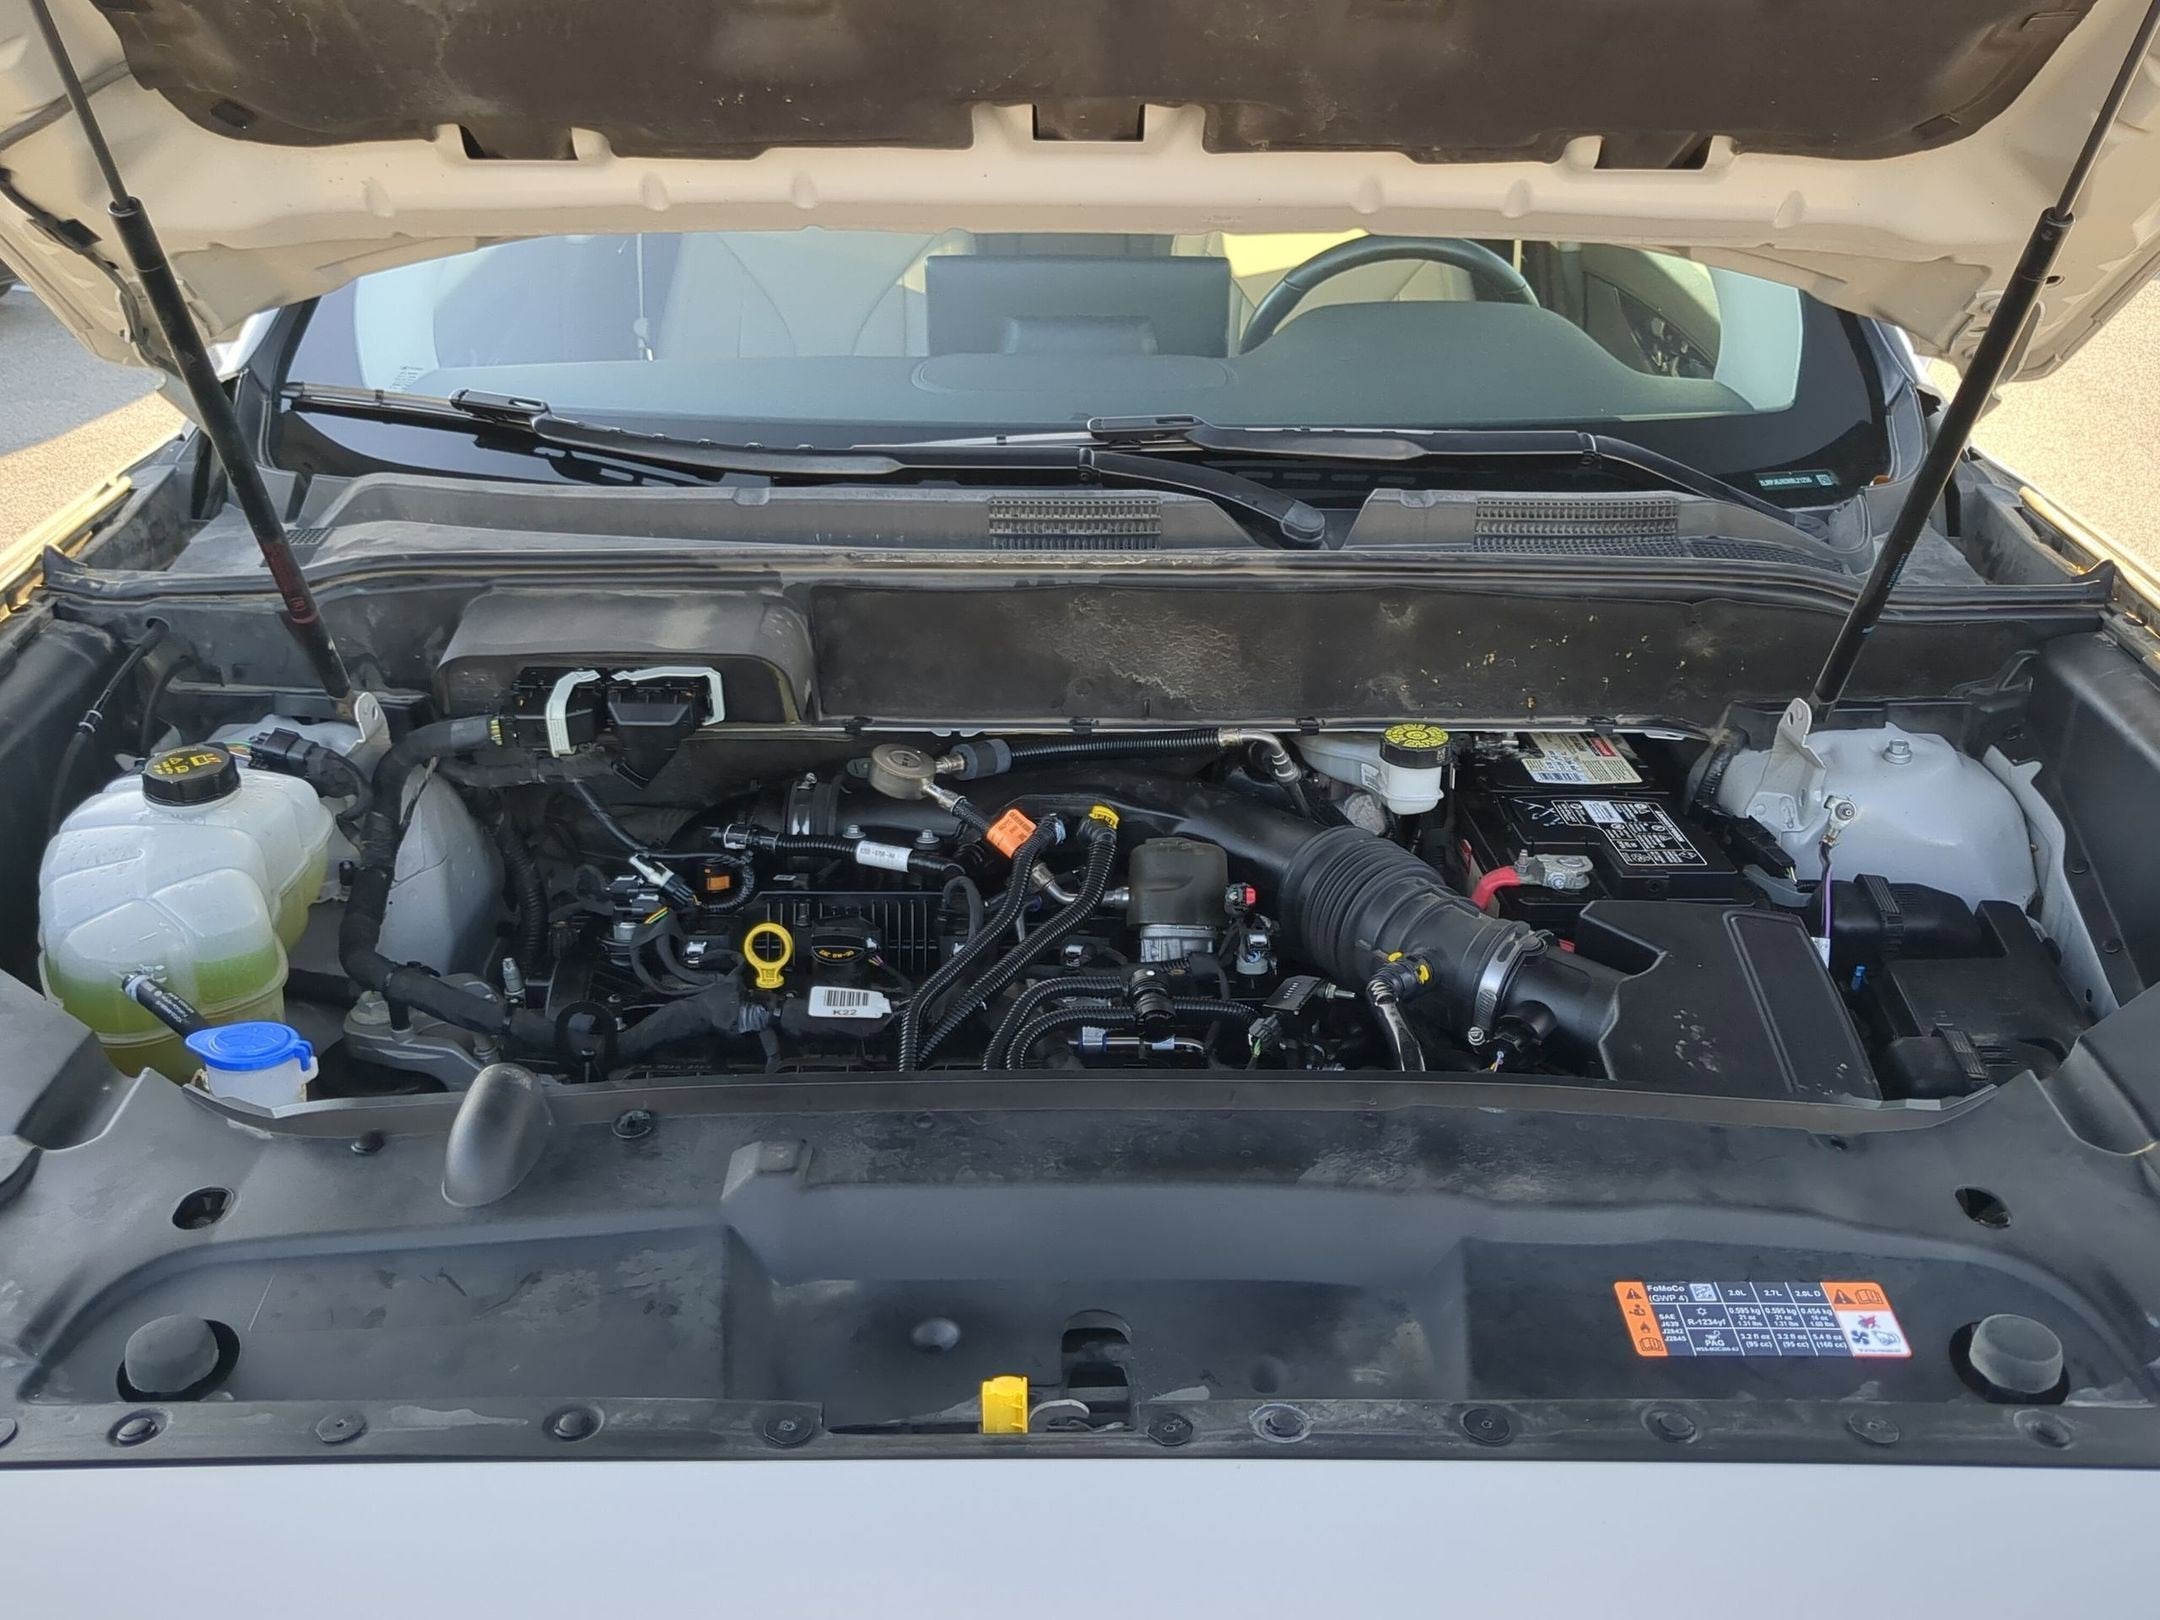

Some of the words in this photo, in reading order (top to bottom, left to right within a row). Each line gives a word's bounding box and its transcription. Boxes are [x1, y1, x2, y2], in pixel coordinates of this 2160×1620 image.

[1648, 1295, 1676, 1303] (GWP
[1678, 1295, 1689, 1303] 4)
[1750, 1307, 1761, 1316] kg
[1786, 1307, 1797, 1316] kg
[1822, 1308, 1833, 1316] kg
[1687, 1319, 1726, 1327] R-1234yf
